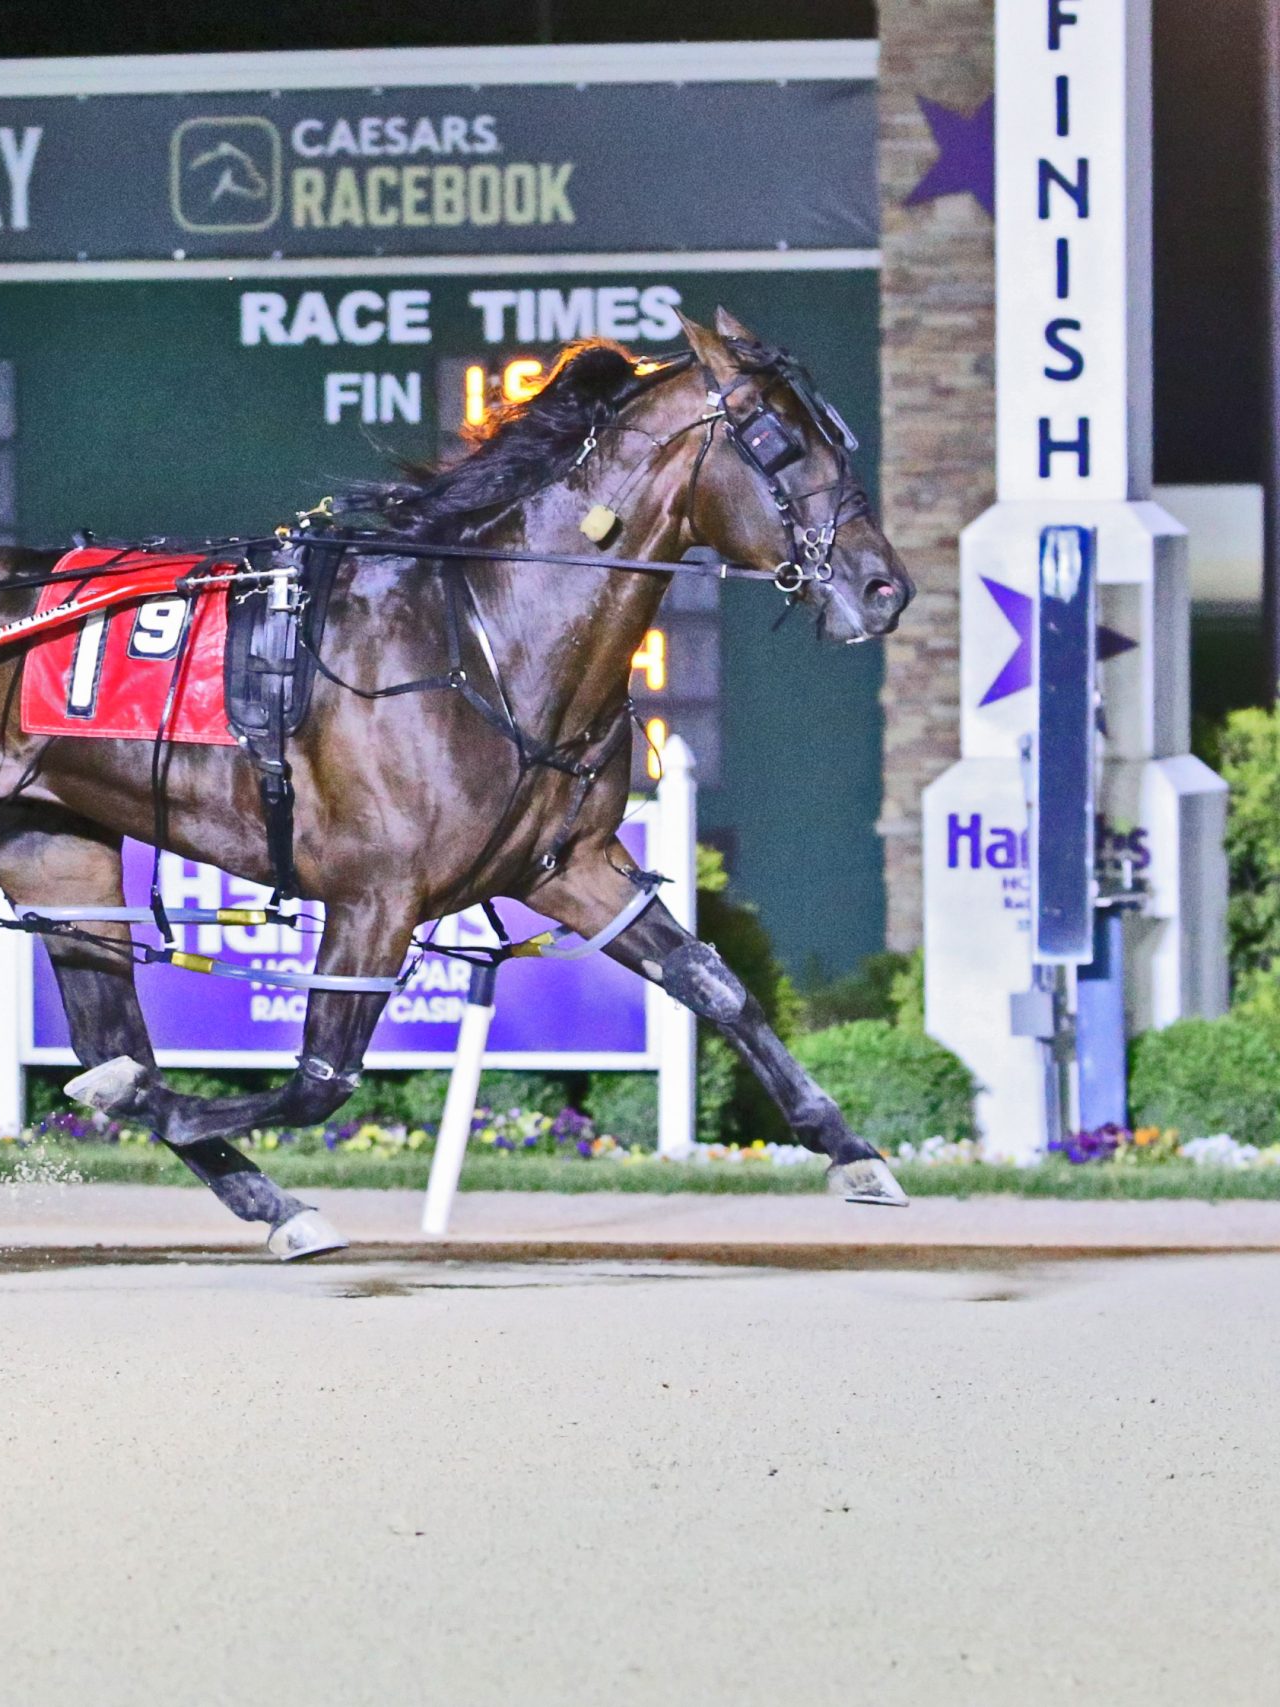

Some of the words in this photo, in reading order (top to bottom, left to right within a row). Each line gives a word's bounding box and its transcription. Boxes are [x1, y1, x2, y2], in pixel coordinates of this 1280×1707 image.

[291, 114, 500, 159] CAESARS
[290, 161, 577, 230] RACEBOOK
[1038, 0, 1090, 479] FINISH
[240, 289, 432, 346] RACE
[469, 285, 683, 343] TIMES
[324, 371, 421, 425] FIN
[128, 595, 189, 660] 9
[407, 959, 473, 992] PAR
